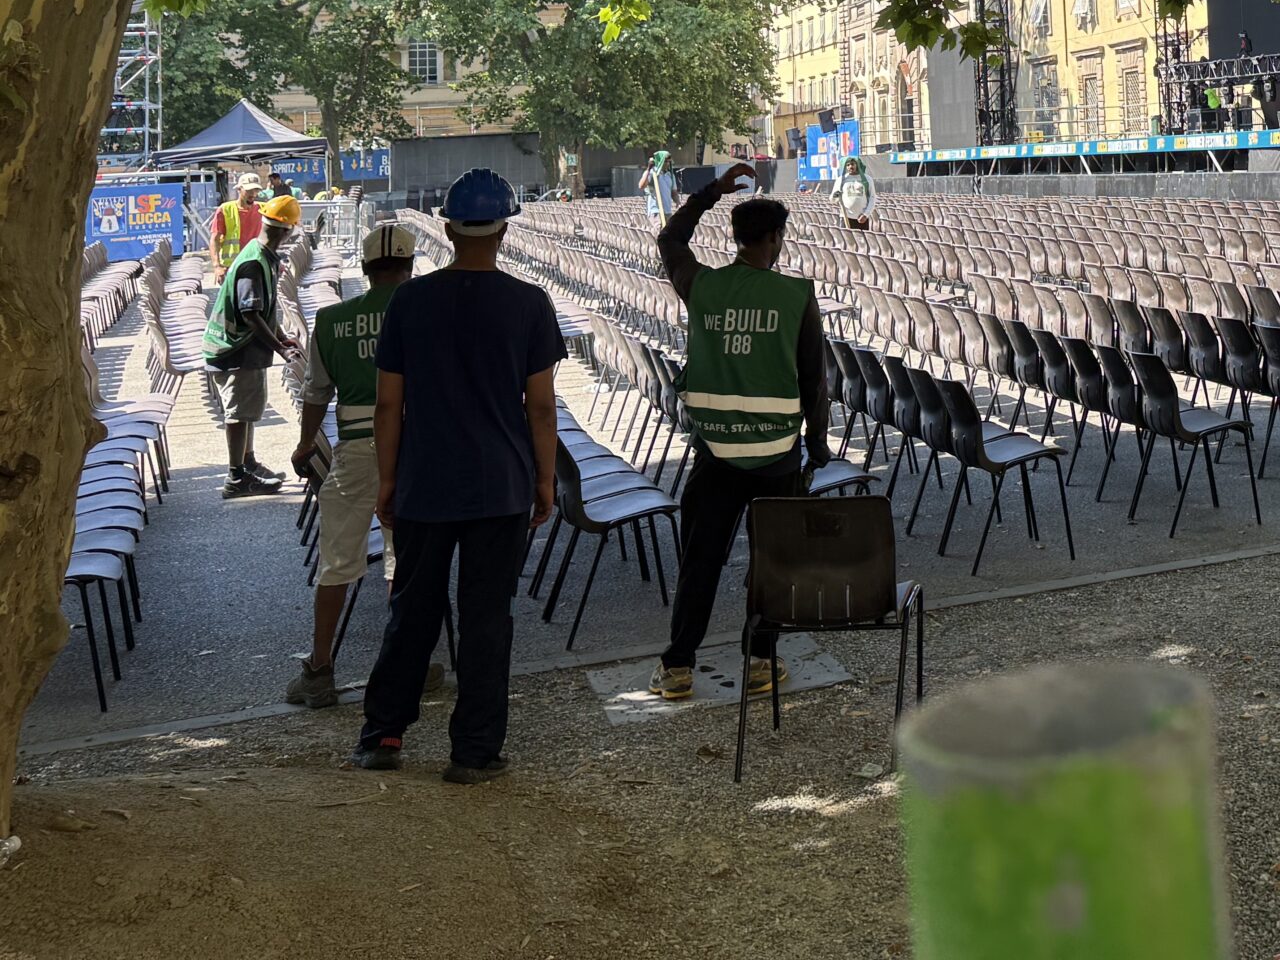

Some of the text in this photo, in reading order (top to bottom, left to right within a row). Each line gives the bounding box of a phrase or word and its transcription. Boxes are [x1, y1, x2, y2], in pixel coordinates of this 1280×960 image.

[273, 162, 296, 174] SPRITZ
[129, 193, 161, 214] LSF
[129, 211, 171, 225] LUCCA
[137, 233, 172, 241] AMERICAN
[704, 308, 779, 333] WE BUILD
[333, 321, 353, 338] WE
[358, 338, 378, 359] 00
[723, 334, 752, 355] 188
[703, 422, 728, 434] SAFE,
[730, 423, 756, 433] STAY
